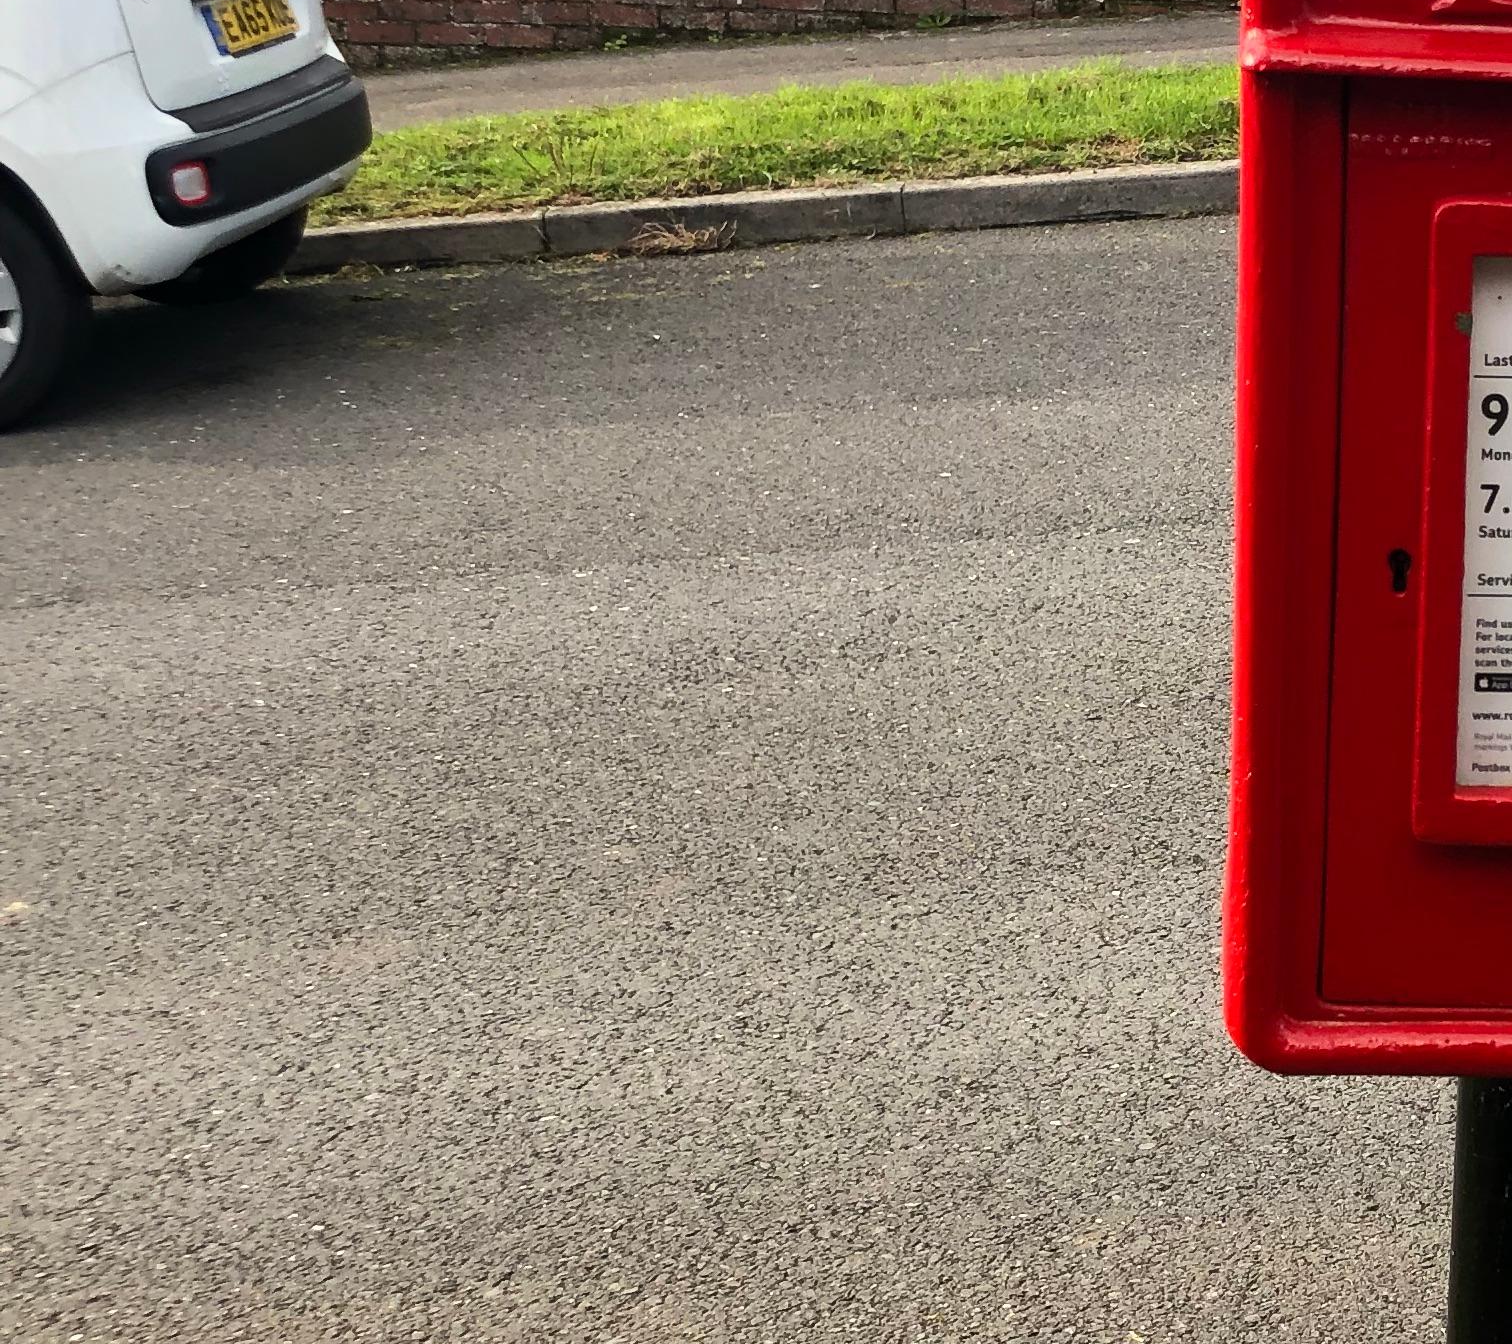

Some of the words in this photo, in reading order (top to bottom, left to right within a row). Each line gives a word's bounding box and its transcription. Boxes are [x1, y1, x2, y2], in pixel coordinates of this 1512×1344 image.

[1476, 618, 1497, 628] Find
[1475, 631, 1492, 641] For
[1474, 658, 1497, 668] scan
[1472, 762, 1511, 772] Postbox
